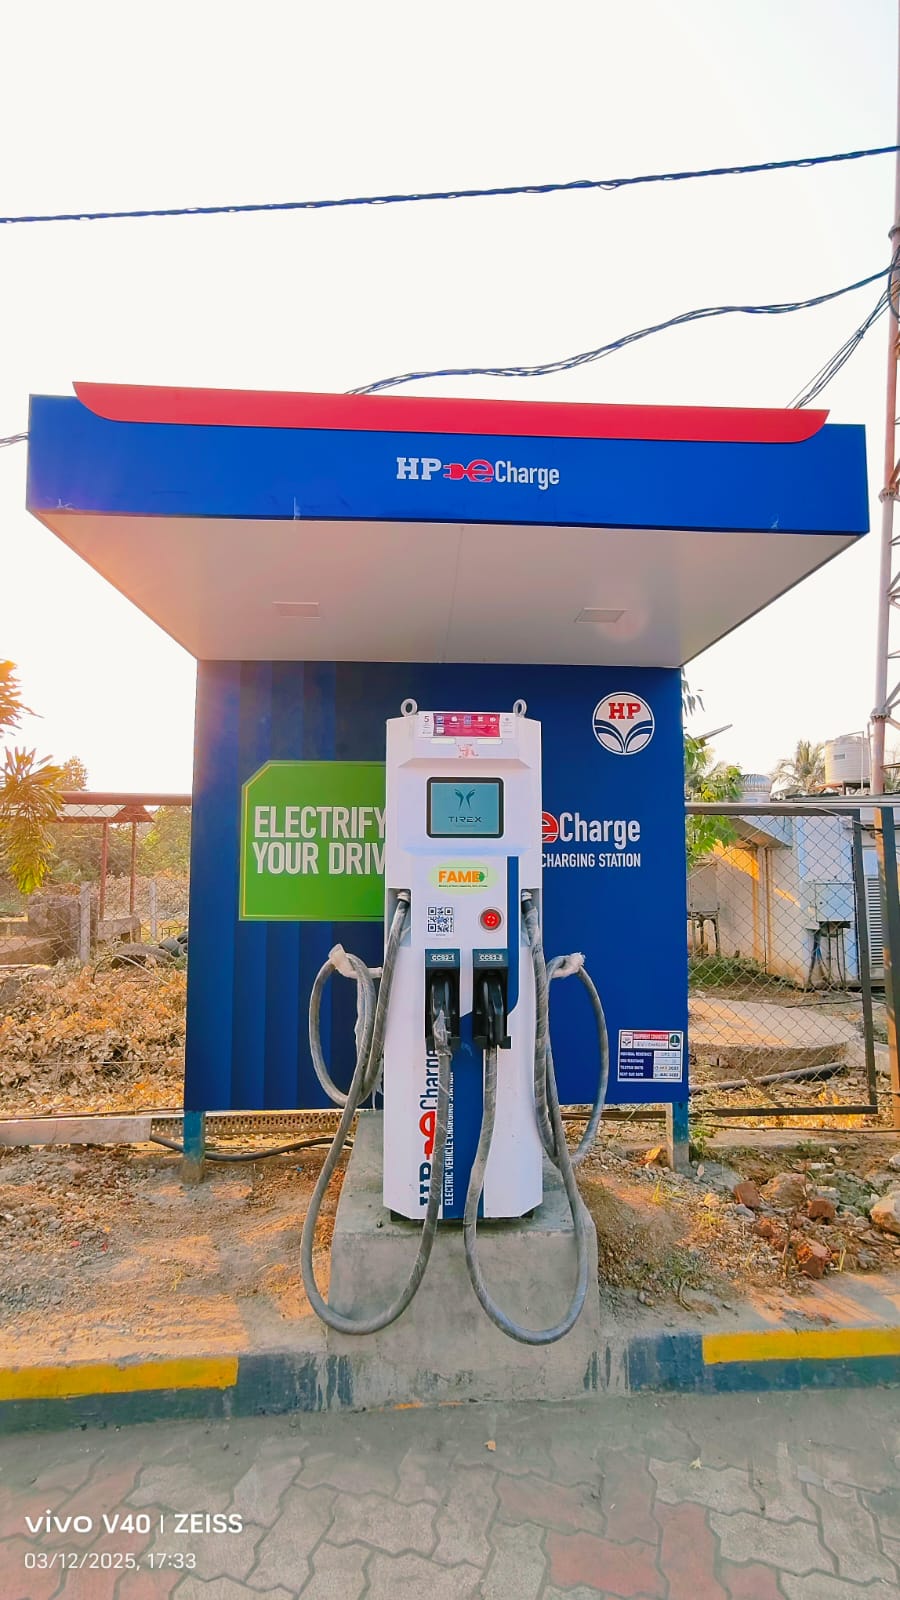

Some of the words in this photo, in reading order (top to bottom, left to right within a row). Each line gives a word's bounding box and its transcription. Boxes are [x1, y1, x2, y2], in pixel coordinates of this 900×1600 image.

[396, 456, 442, 481] HP
[608, 702, 641, 720] HP
[254, 805, 387, 839] ELECTRIFY
[447, 815, 482, 823] TIREX
[252, 841, 319, 875] YOUR
[541, 853, 595, 868] CHARGING
[598, 853, 641, 868] STATION
[445, 1140, 454, 1171] VEHICLE
[444, 1171, 454, 1206] ELECTRIC
